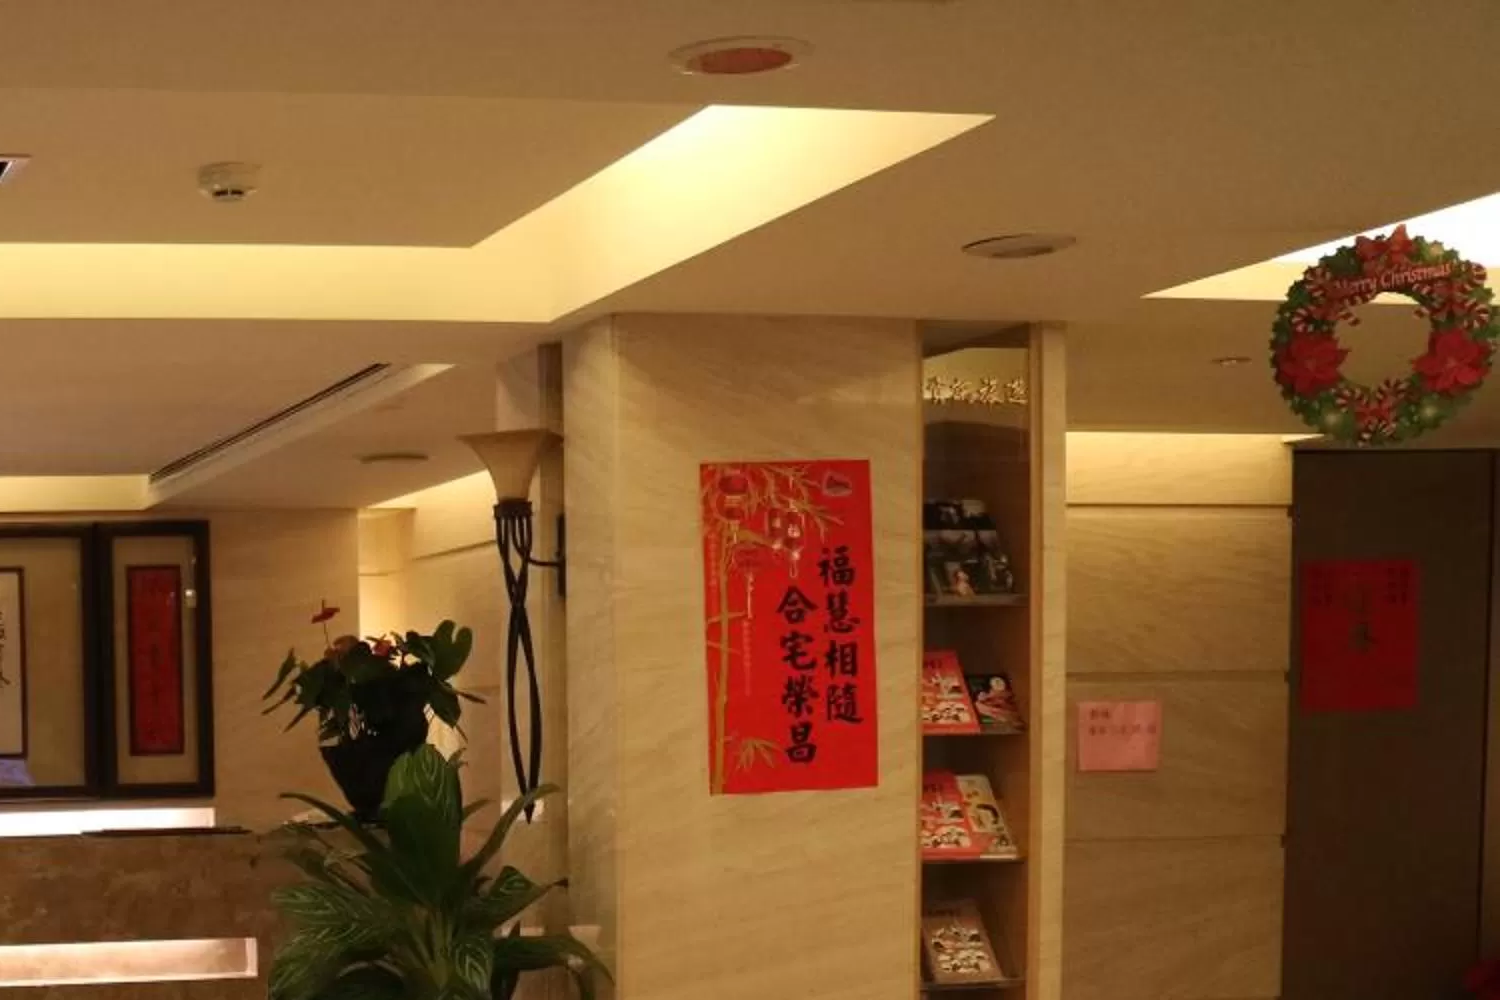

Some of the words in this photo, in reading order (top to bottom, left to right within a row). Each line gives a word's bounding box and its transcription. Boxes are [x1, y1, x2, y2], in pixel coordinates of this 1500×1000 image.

[1334, 277, 1377, 295] Merry
[1380, 263, 1452, 288] Christmas
[776, 585, 820, 764] 合宅榮昌
[817, 545, 865, 724] 福慧相隨
